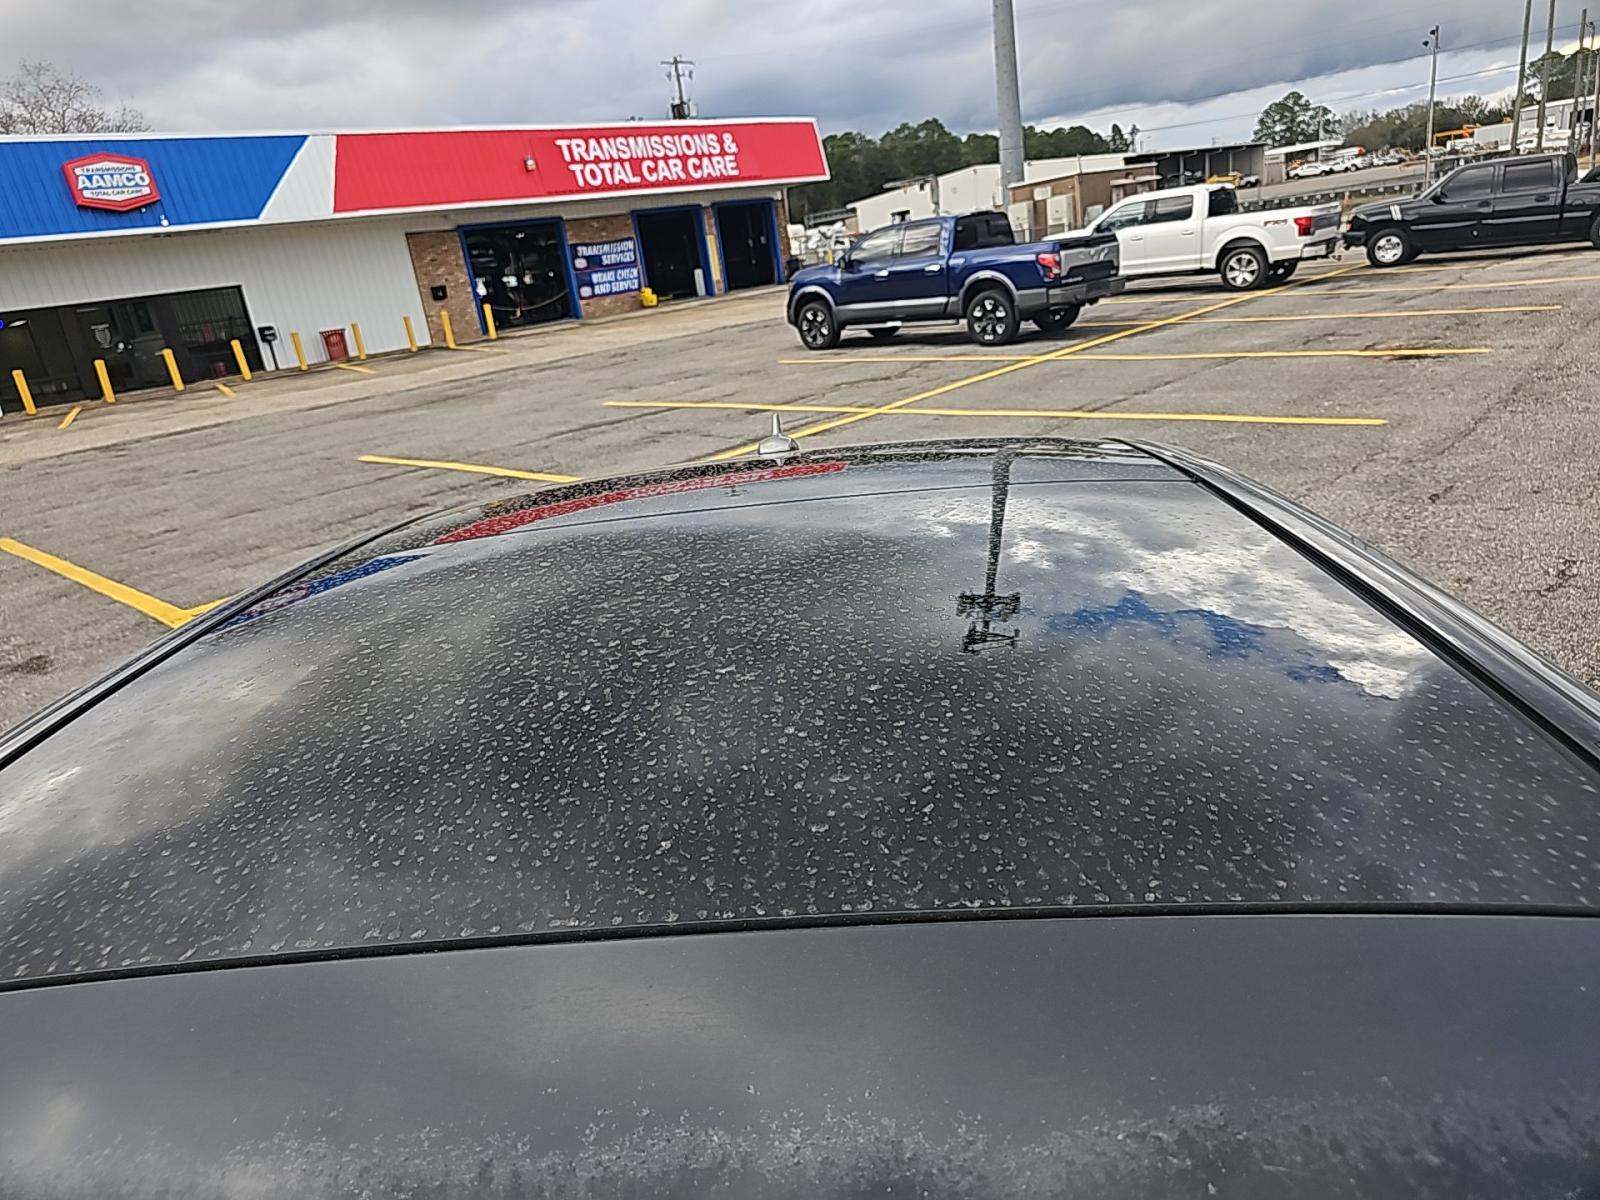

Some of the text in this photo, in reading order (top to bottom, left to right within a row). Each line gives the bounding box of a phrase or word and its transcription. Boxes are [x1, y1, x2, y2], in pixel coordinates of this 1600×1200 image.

[554, 132, 738, 162] TRANSMISSIONS &
[78, 173, 150, 190] AAMCO
[568, 155, 740, 188] TOTAL CAR CARE
[594, 282, 611, 295] AND
[611, 279, 639, 293] SERVICE
